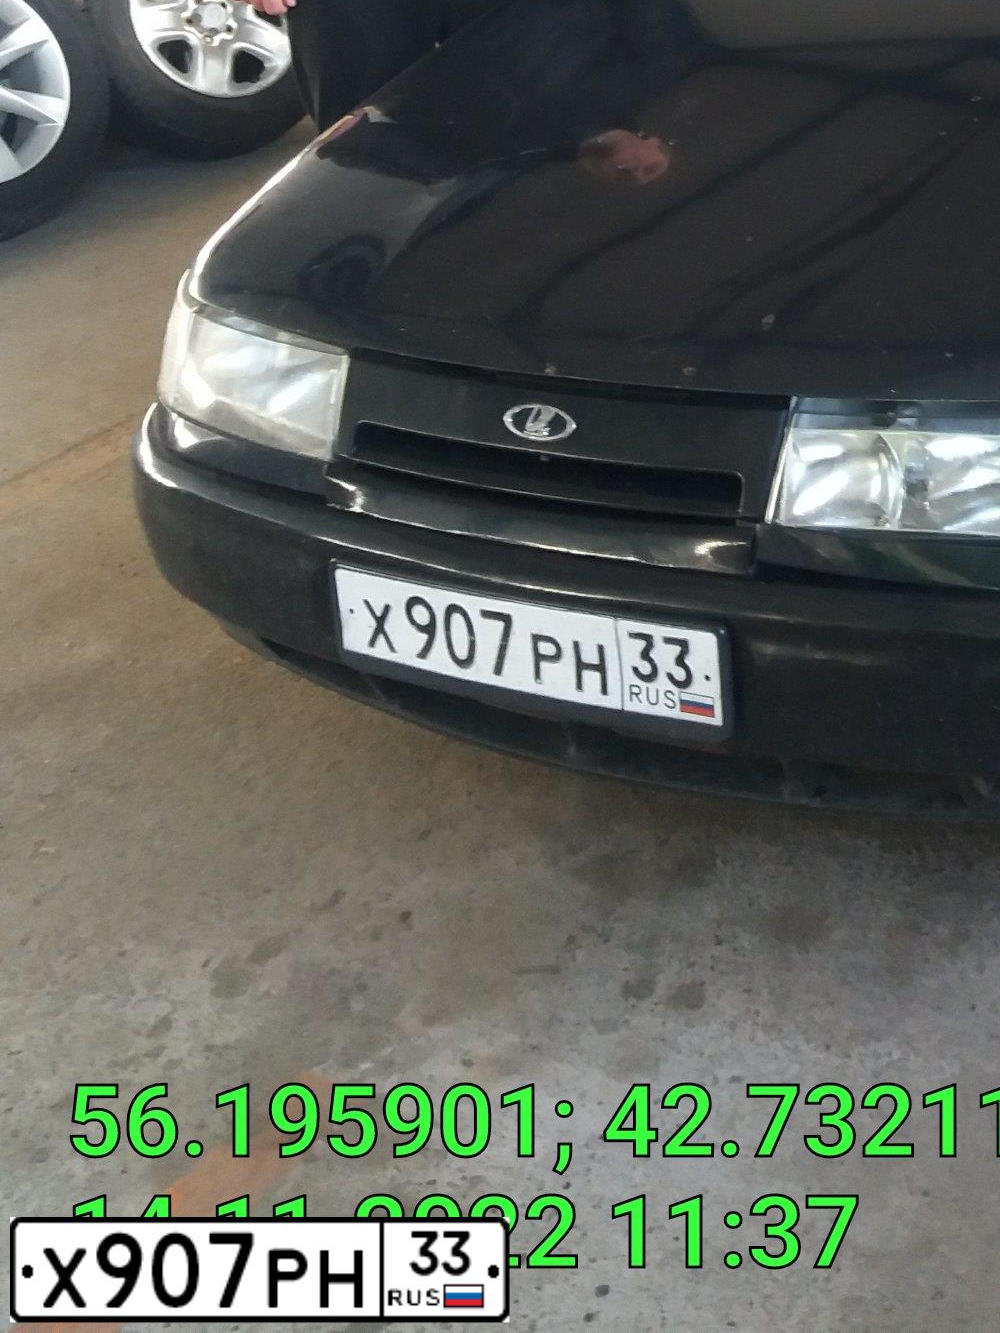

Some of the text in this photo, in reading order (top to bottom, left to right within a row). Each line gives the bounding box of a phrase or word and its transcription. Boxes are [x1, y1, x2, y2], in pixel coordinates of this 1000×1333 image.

[363, 595, 693, 697] Х907РН 33
[628, 683, 677, 710] RUS
